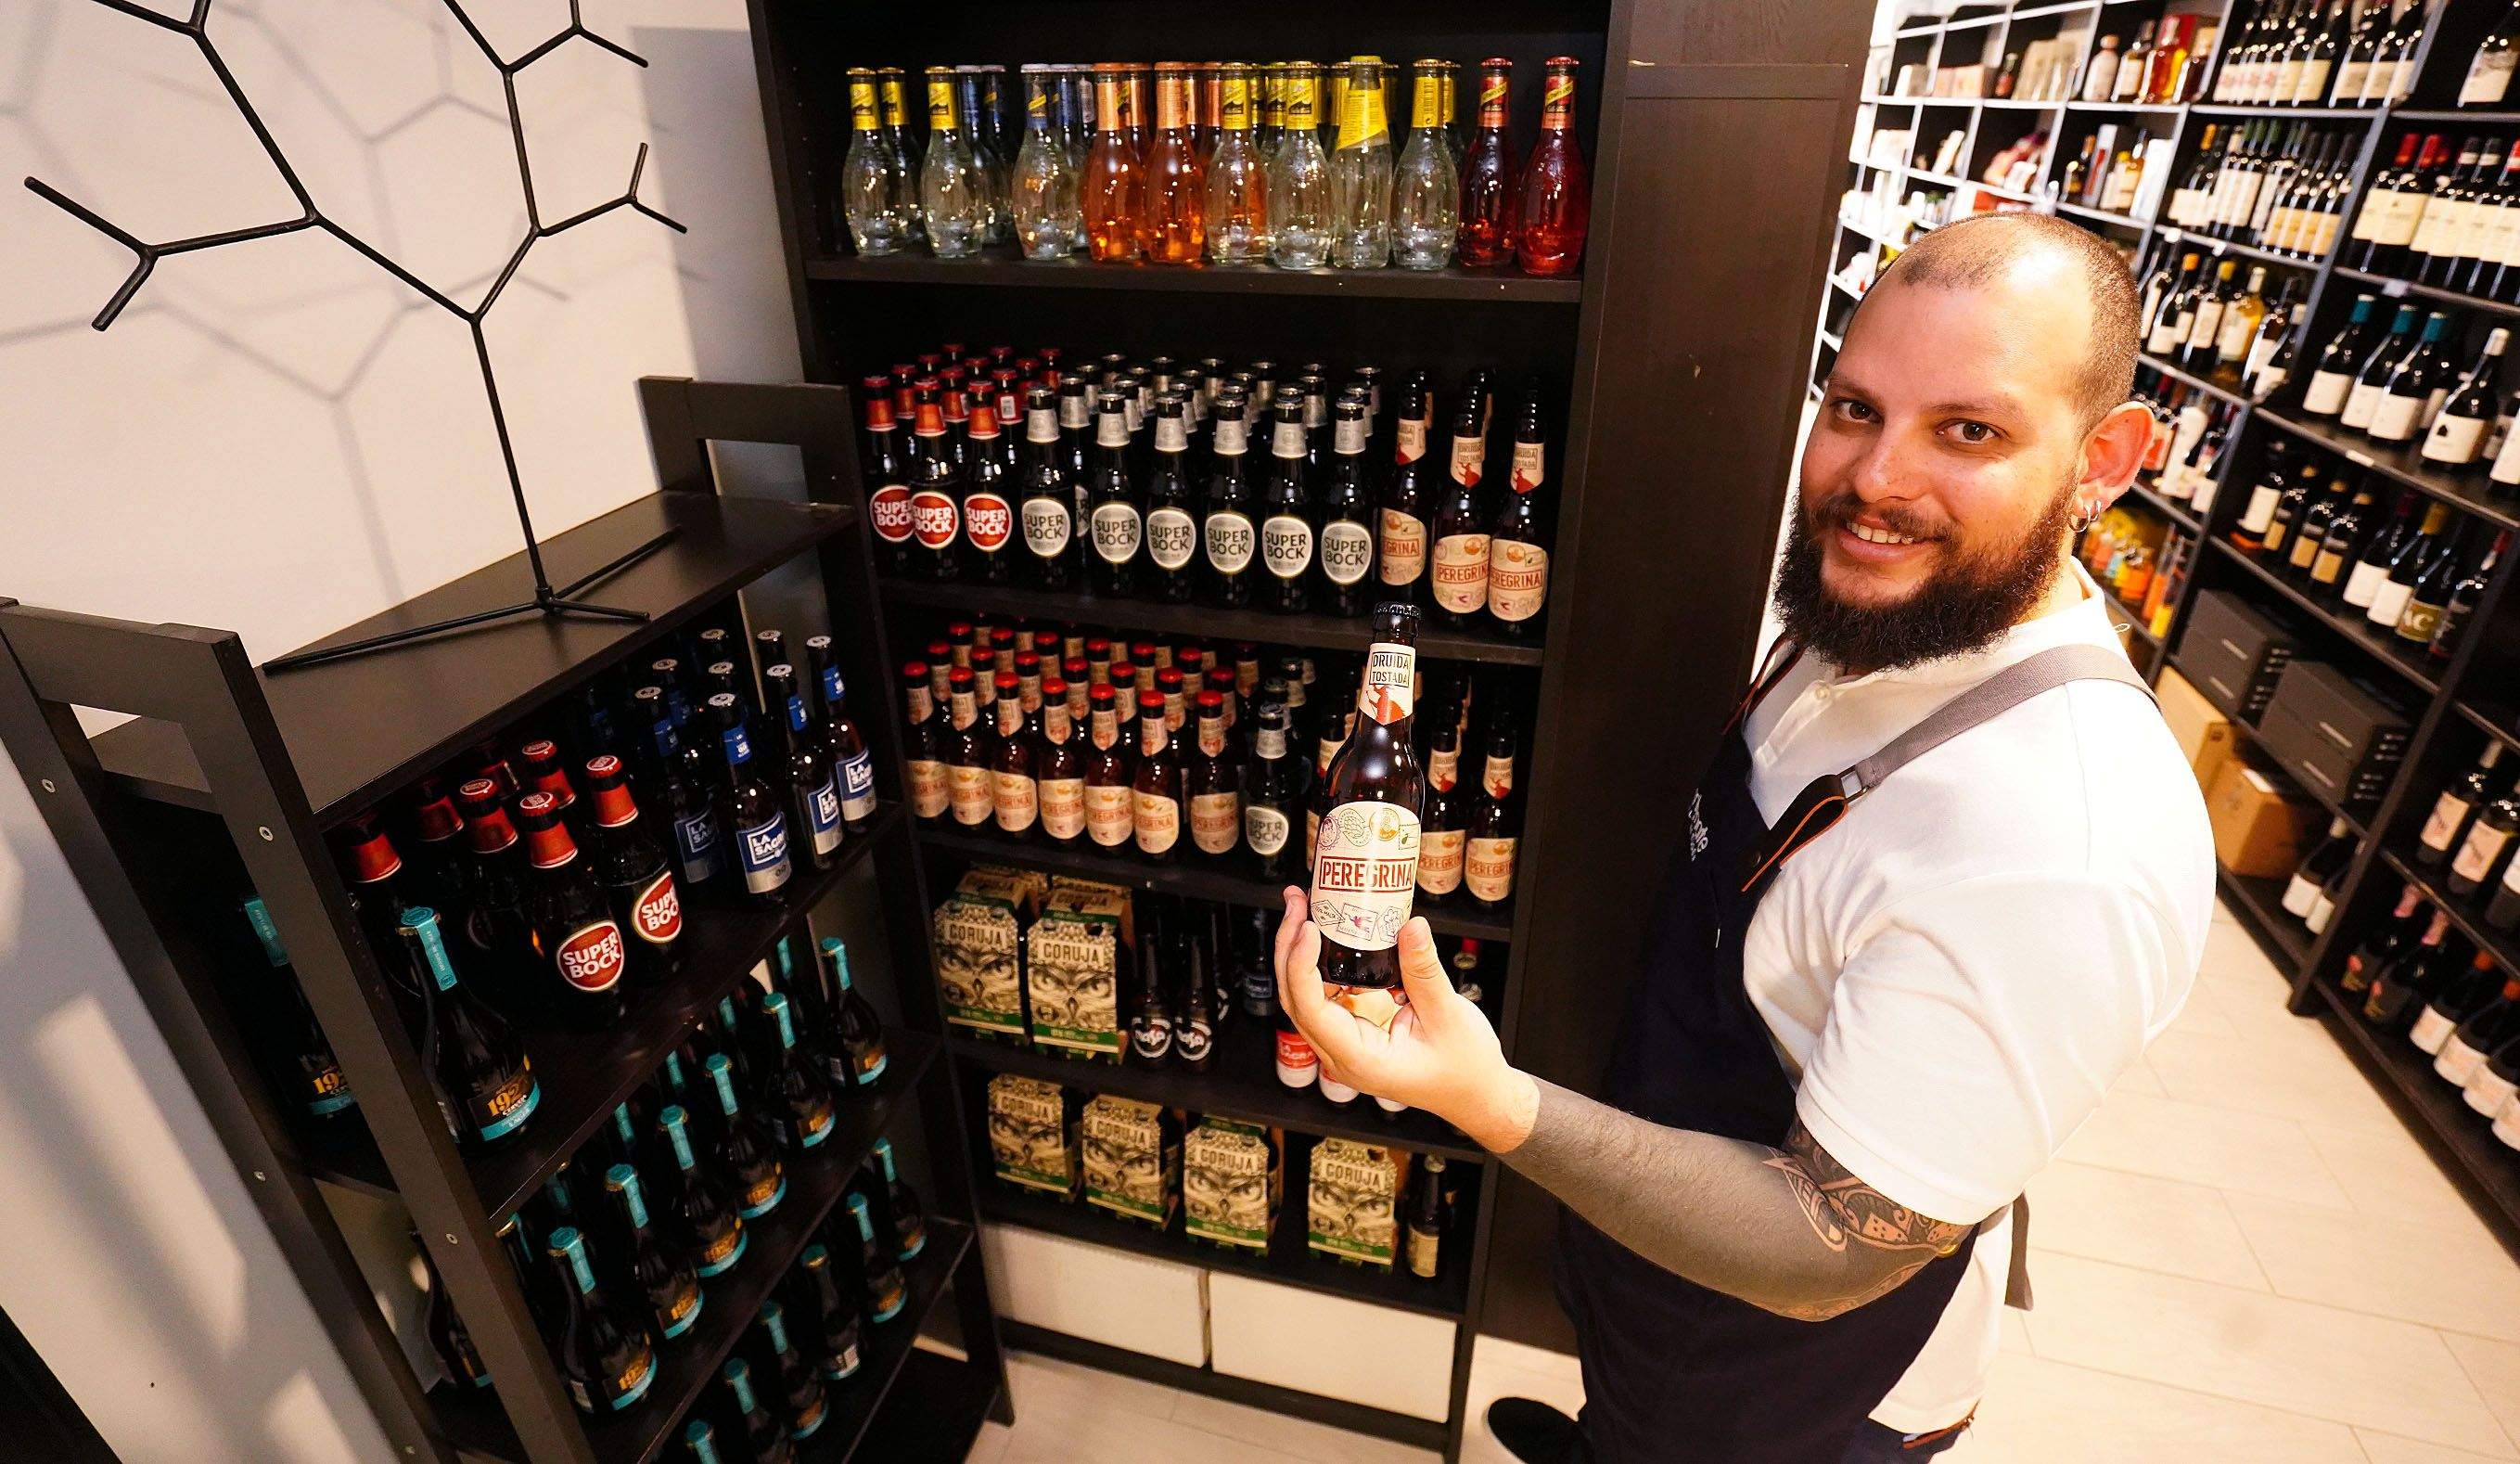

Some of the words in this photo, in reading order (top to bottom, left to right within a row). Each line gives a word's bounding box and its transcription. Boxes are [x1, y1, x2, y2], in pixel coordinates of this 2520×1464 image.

[914, 507, 953, 521] SUPER
[966, 508, 1006, 523] SUPER
[1025, 514, 1064, 528] SUPER
[915, 520, 953, 533] BOCK
[968, 520, 1006, 535] BOCK
[1028, 525, 1064, 540] BOCK
[1094, 518, 1137, 533] SUPER
[1149, 524, 1191, 539] SUPER
[1097, 532, 1136, 546] BOCK
[1208, 527, 1249, 543] SUPER
[1264, 531, 1307, 546] SUPER
[1151, 537, 1190, 552] BOCK
[1209, 541, 1248, 556] BOCK
[1266, 545, 1305, 559] BOCK
[1324, 536, 1367, 554] SUPER
[1325, 550, 1365, 566] BOCK
[1372, 654, 1409, 670] DRUIDA
[1372, 671, 1408, 685] TOSTADA
[751, 834, 772, 847] LA
[1322, 861, 1413, 889] PEREGRINA
[562, 931, 619, 966] SUPER
[569, 944, 621, 979] BOCK
